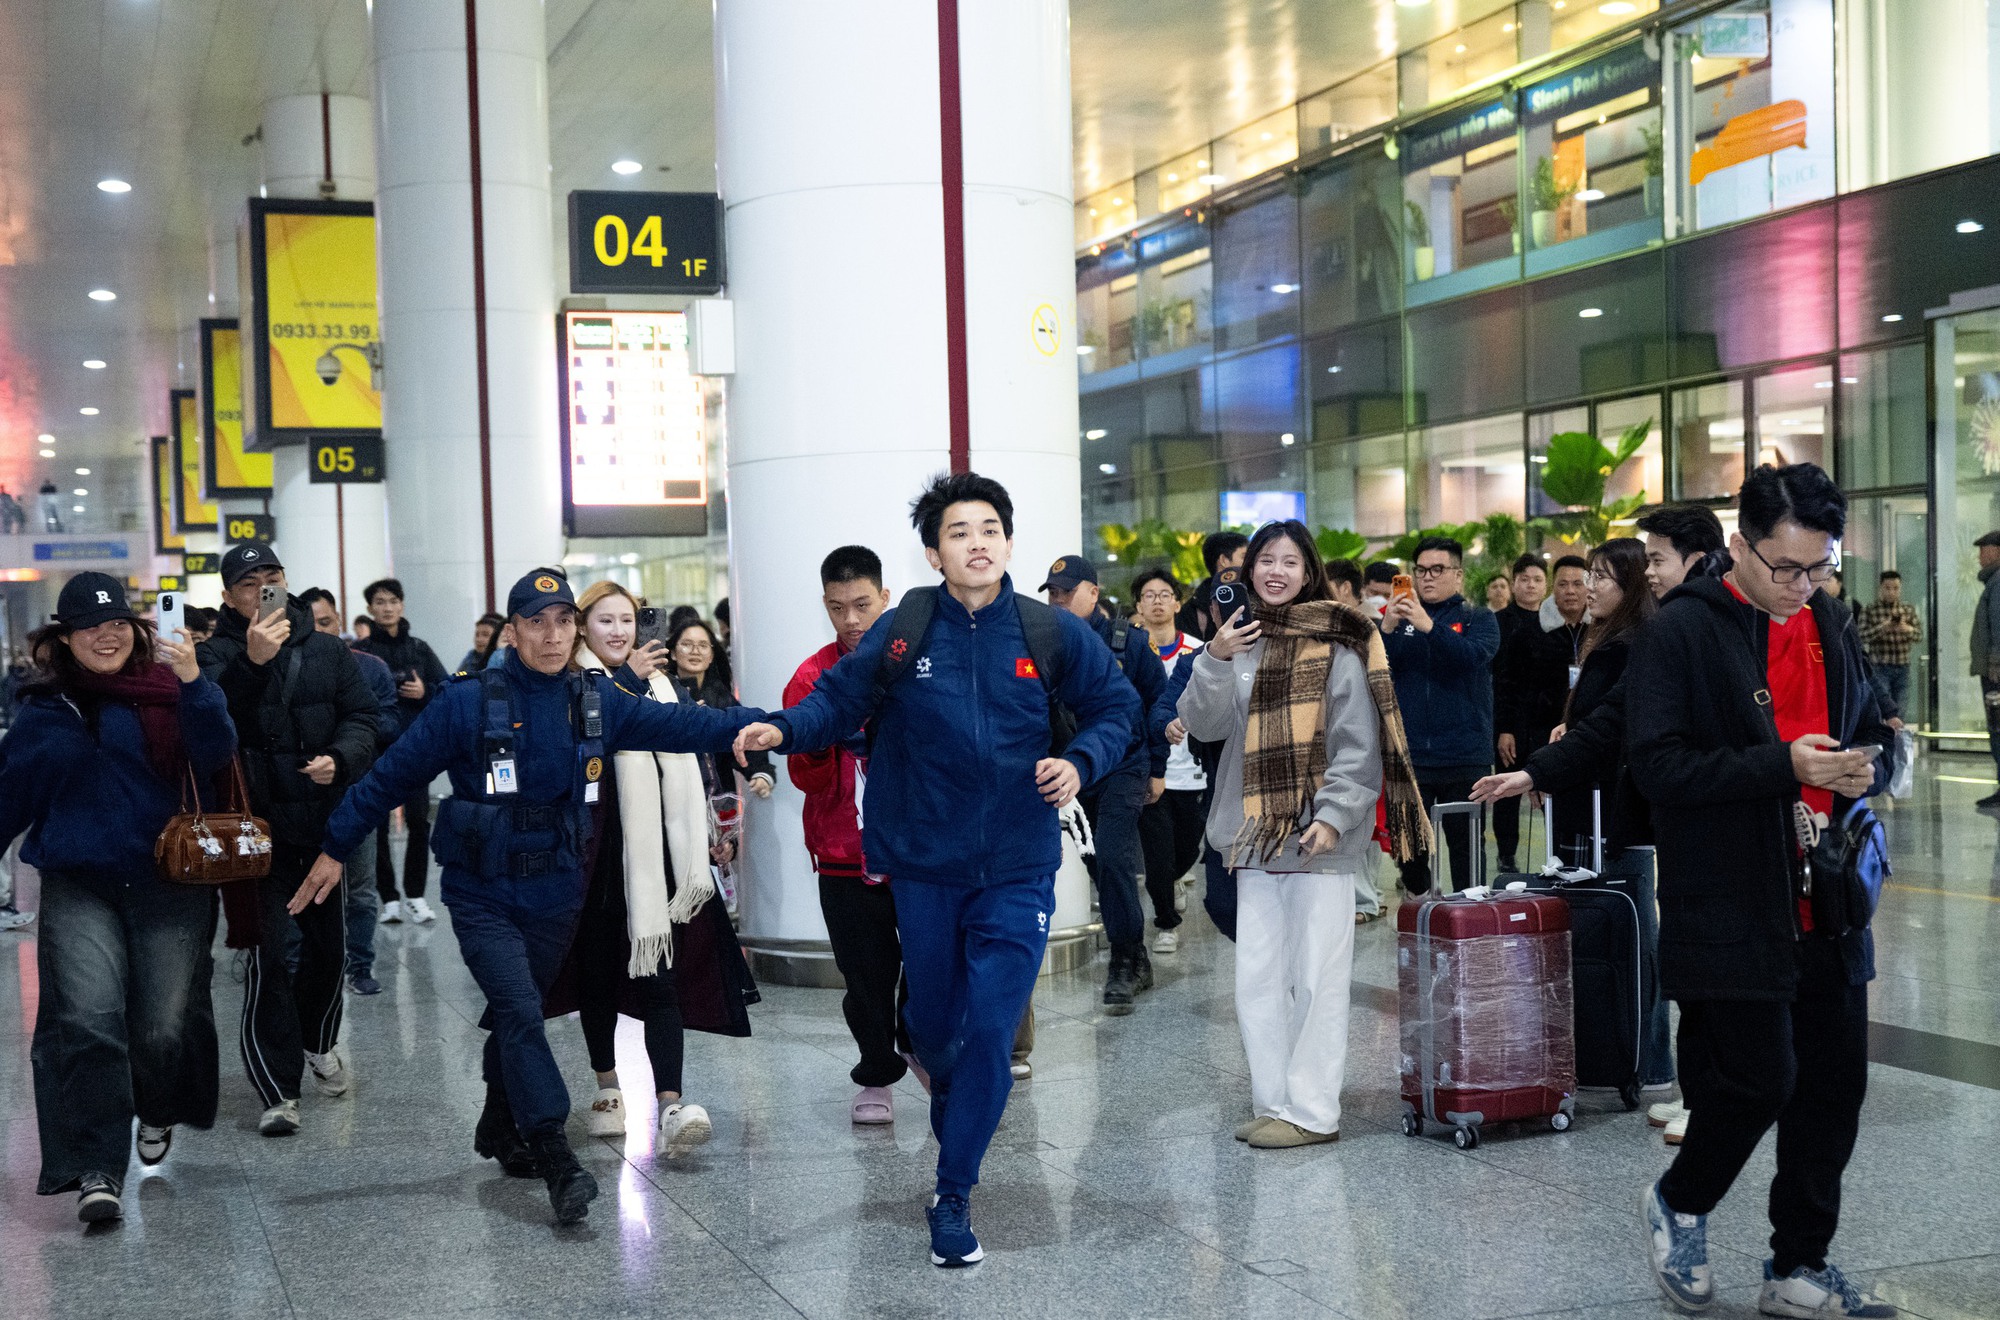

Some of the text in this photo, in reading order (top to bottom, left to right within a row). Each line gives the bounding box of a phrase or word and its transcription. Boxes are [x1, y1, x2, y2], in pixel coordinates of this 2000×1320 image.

[593, 214, 707, 277] 04 1F
[317, 447, 356, 473] 05
[229, 520, 256, 539] 06
[186, 557, 206, 571] 07
[95, 590, 112, 604] R
